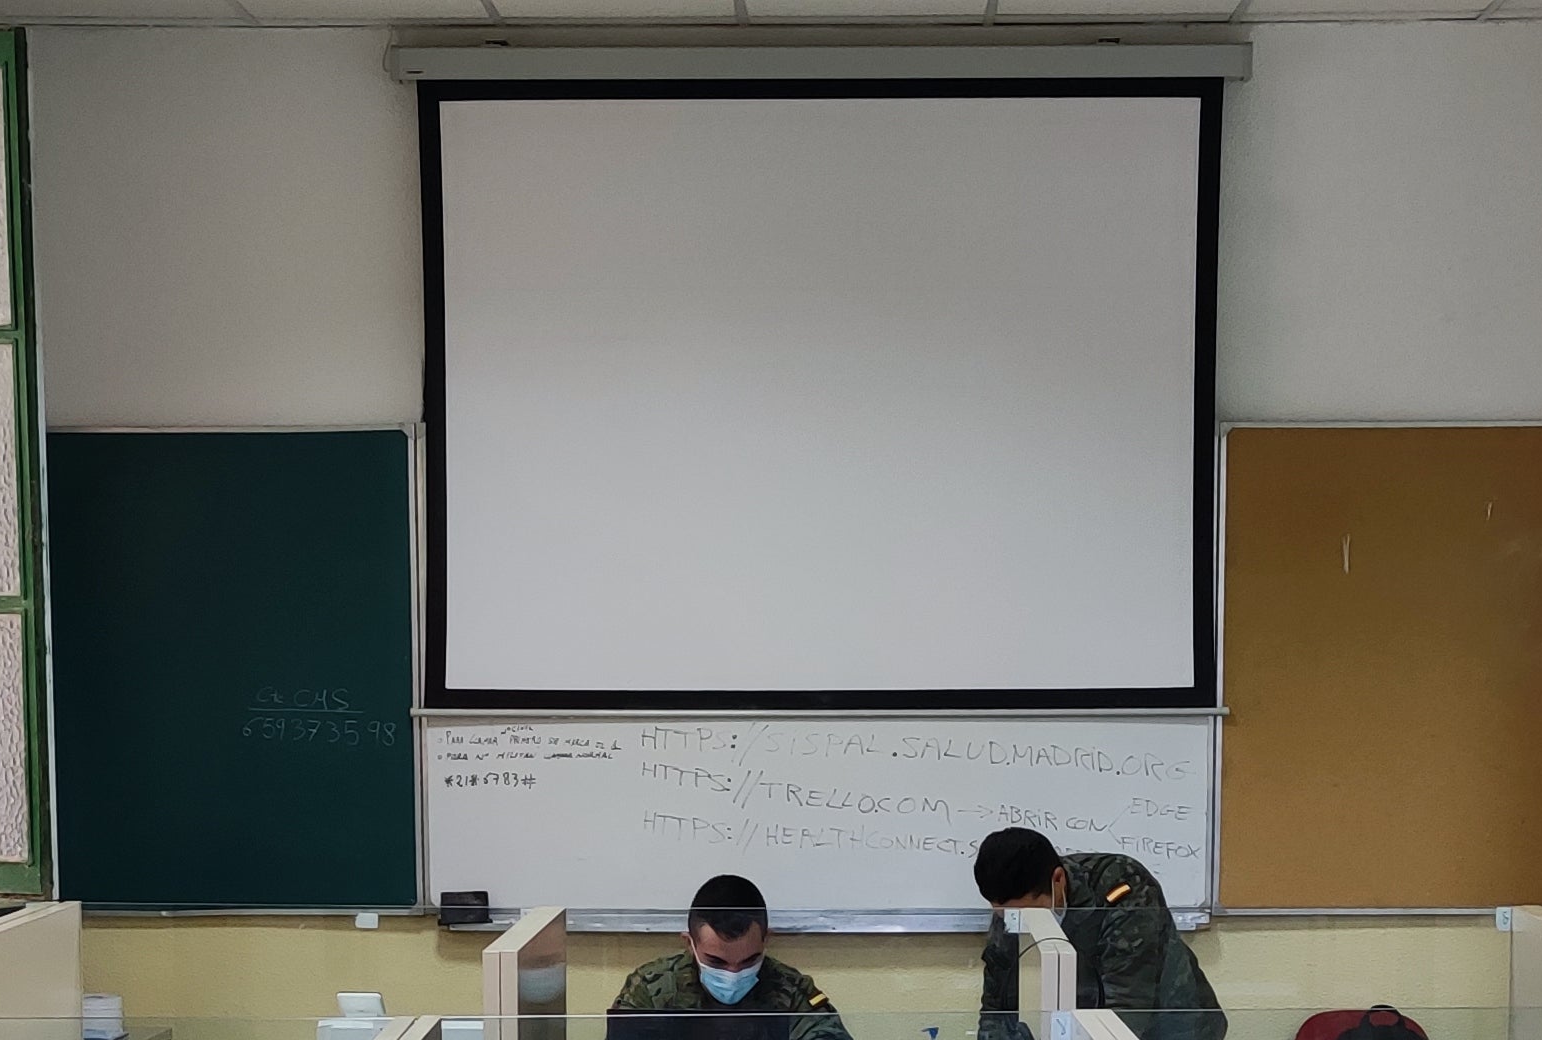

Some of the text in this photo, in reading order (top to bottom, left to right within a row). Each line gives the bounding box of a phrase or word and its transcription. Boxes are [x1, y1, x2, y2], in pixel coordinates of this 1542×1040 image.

[998, 804, 1058, 831] ABRIR
[1130, 797, 1191, 821] EDGE
[1121, 835, 1202, 861] FIREFOX
